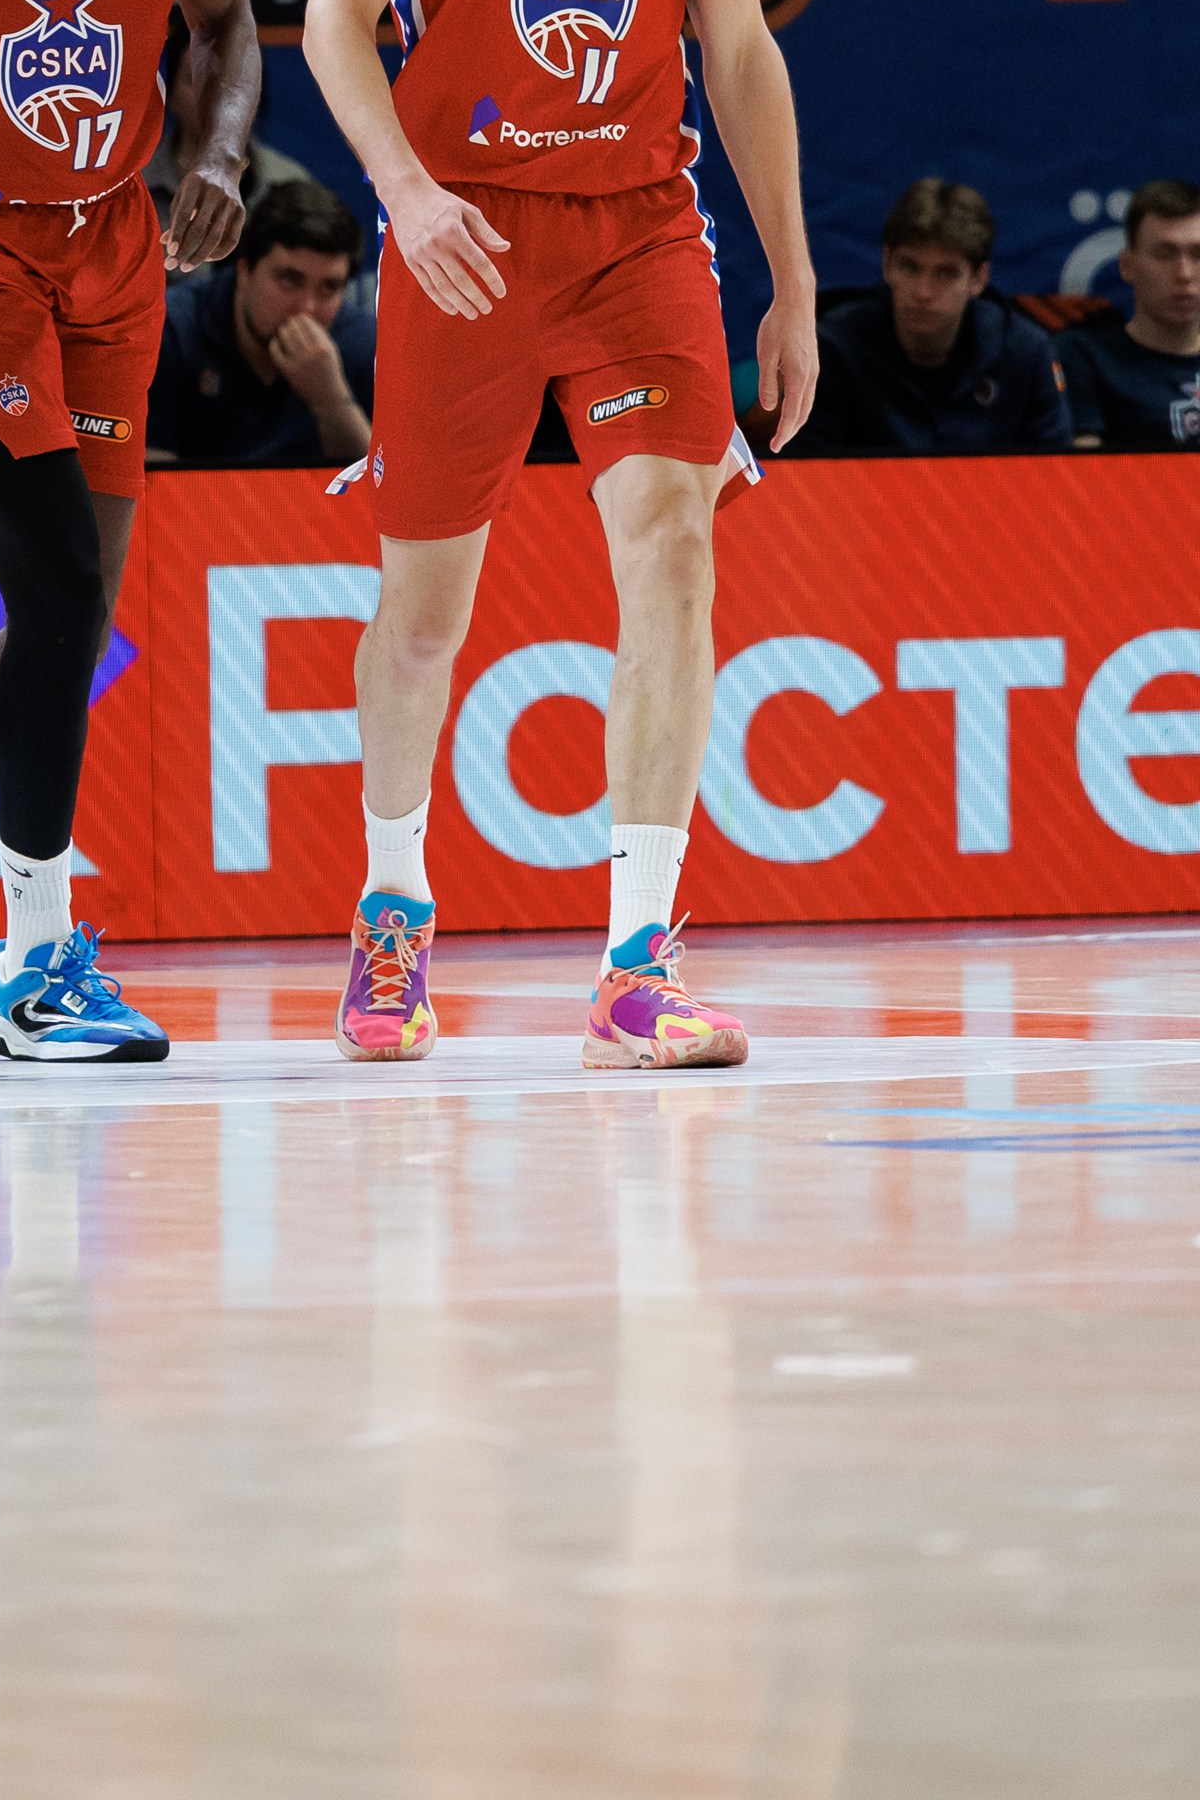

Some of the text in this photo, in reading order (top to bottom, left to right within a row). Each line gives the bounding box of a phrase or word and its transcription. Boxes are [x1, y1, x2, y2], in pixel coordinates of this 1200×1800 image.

[16, 44, 107, 78] CSKA
[576, 46, 620, 105] 11
[73, 109, 123, 172] 17
[499, 120, 631, 148] Ростелеко
[0, 388, 26, 402] CSKA
[593, 390, 647, 420] WINLINE
[205, 562, 1200, 873] Росте
